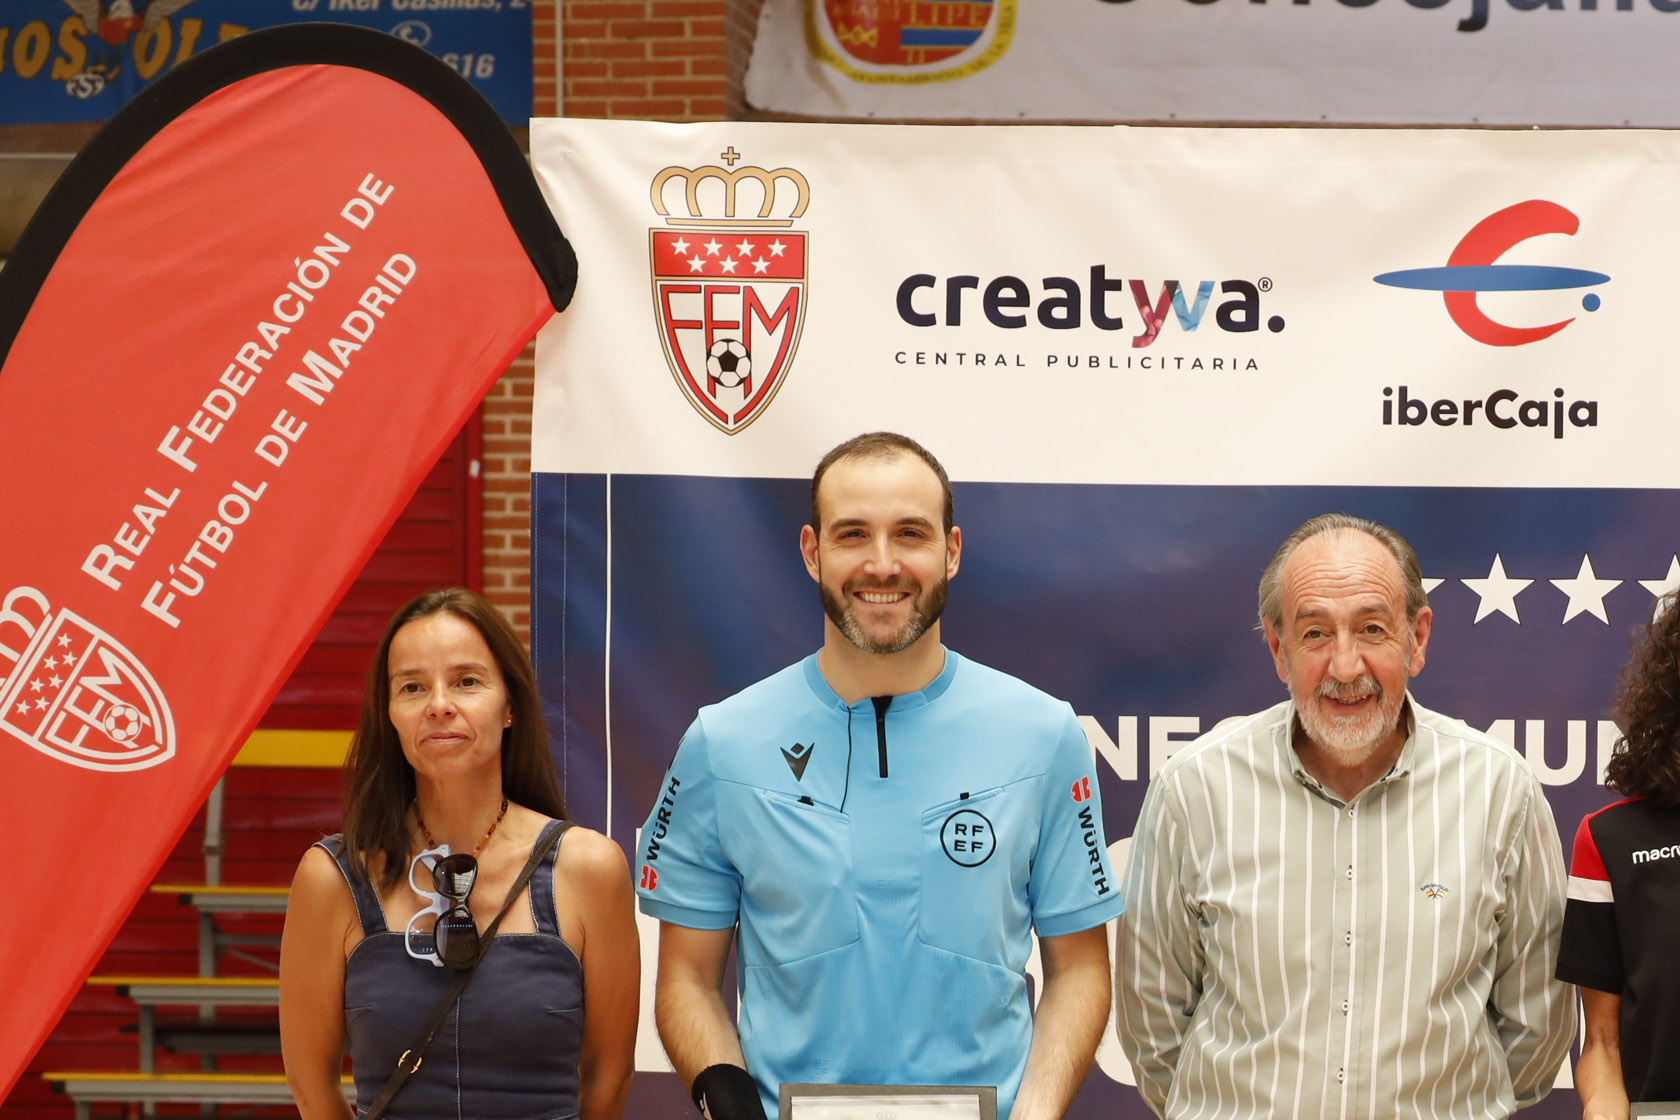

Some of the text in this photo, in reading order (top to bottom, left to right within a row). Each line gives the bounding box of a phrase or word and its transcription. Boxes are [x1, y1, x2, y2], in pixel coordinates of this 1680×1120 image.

[81, 172, 395, 590] REAL FEDERACIÓN DE
[895, 351, 1260, 372] CENTRAL PUBLICITARIA
[140, 252, 418, 628] FÚTBOL DE MADRID
[1382, 386, 1598, 439] iberCaja
[646, 777, 681, 861] WÜRTH
[1078, 806, 1110, 896] WÜRTH
